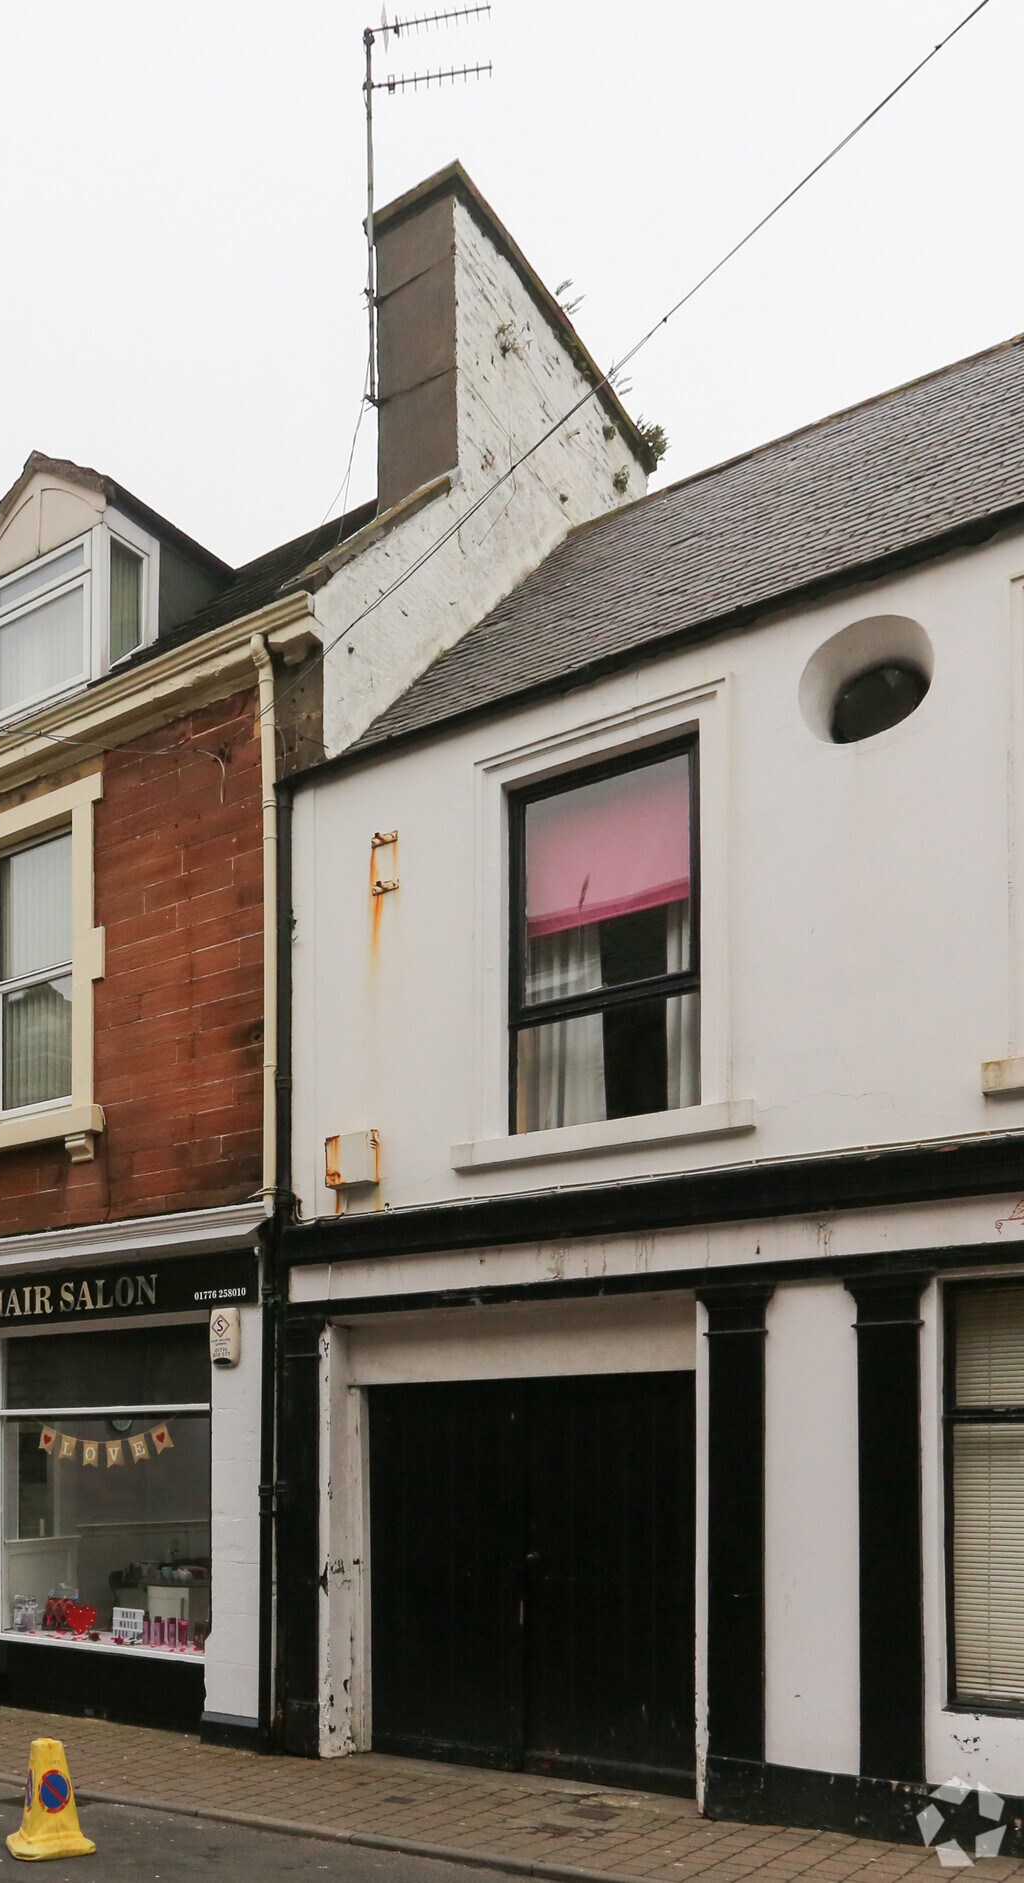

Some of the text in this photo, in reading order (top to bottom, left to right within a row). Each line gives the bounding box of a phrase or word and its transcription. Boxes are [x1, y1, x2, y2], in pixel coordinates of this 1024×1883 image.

[59, 1273, 159, 1313] SALON
[194, 1287, 246, 1301] 01776 258010
[217, 1320, 224, 1332] S
[62, 1441, 146, 1461] LOVE
